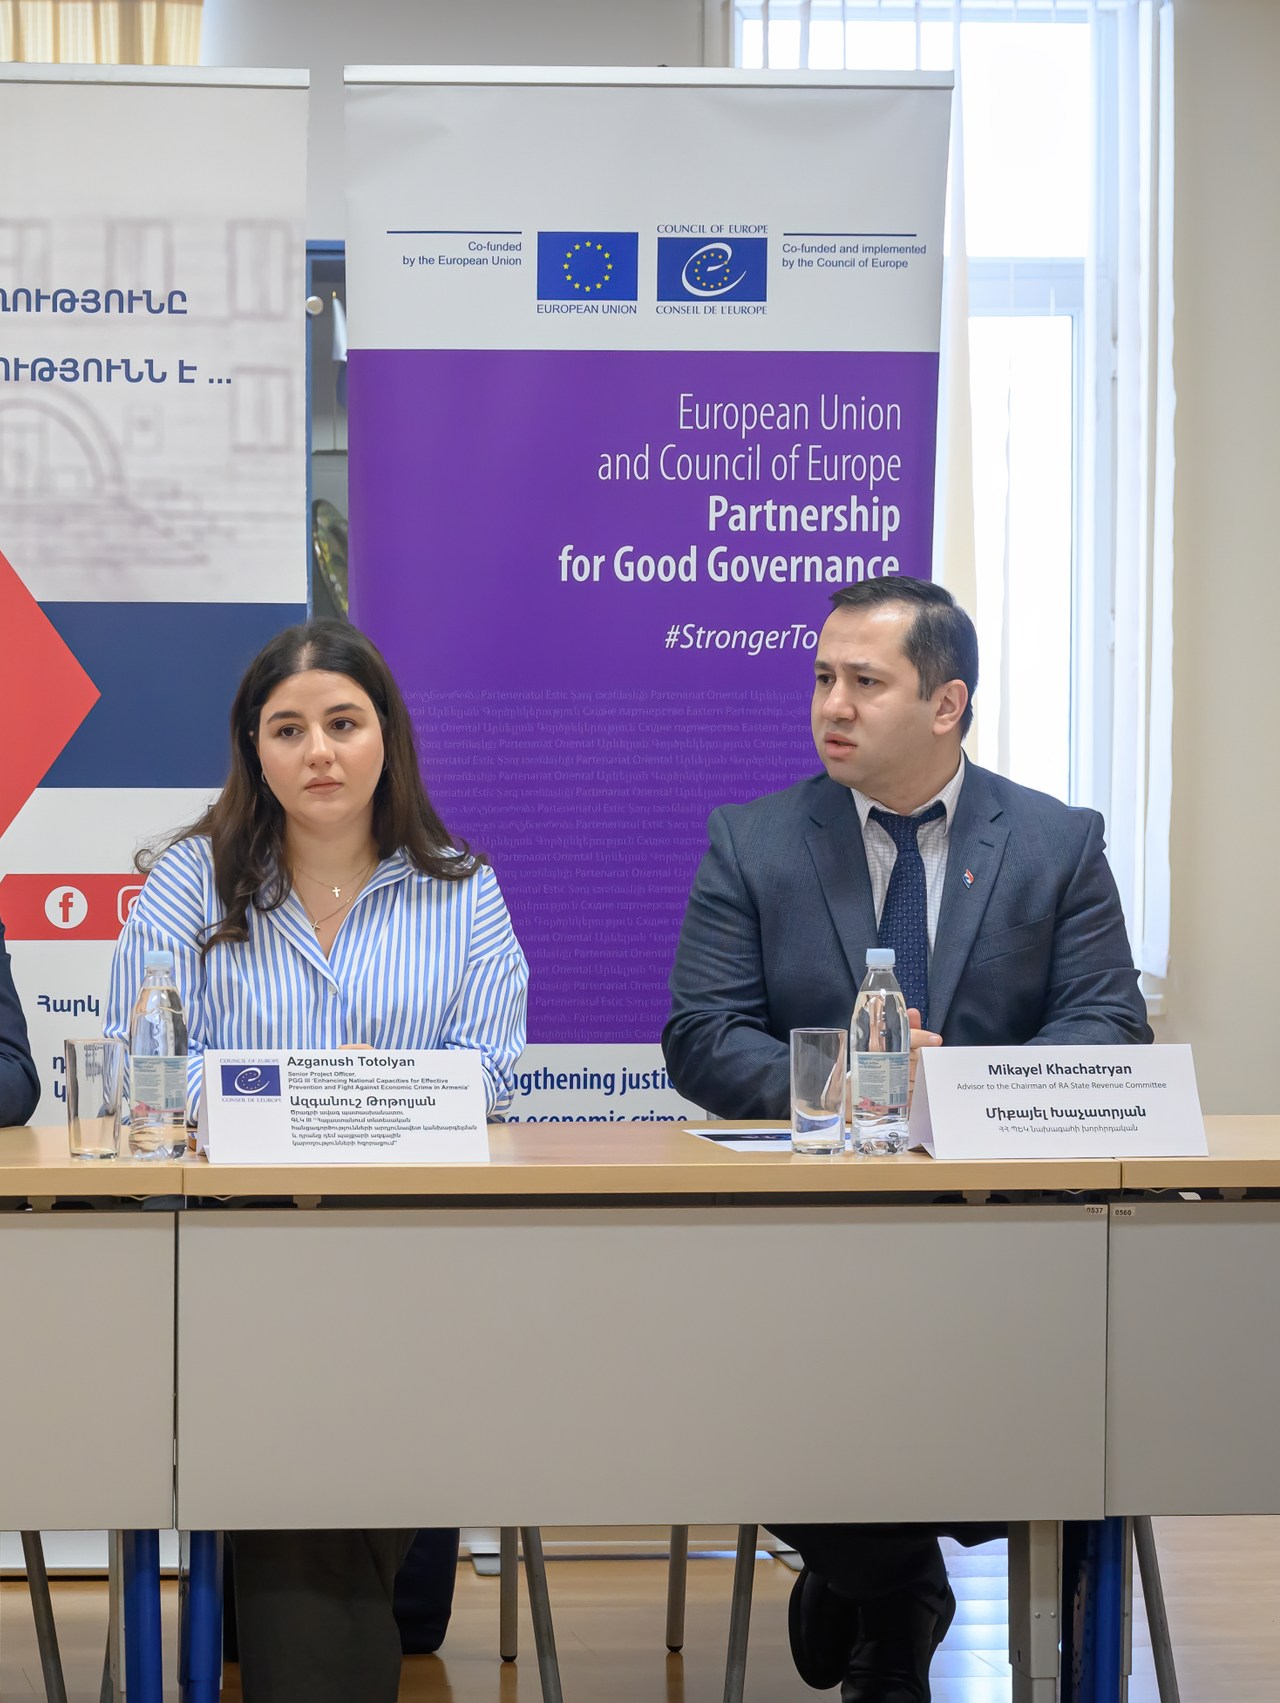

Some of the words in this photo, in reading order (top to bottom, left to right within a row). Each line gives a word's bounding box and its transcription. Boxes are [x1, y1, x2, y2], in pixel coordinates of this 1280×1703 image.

[657, 225, 706, 233] COUNCIL
[711, 225, 724, 233] OF
[729, 225, 767, 233] EUROPE
[468, 241, 521, 251] Co-funded
[783, 244, 836, 253] Co-funded
[840, 244, 858, 253] and
[862, 244, 926, 255] implemented
[403, 256, 415, 267] by
[419, 256, 435, 264] the
[439, 255, 488, 267] European
[492, 256, 521, 265] Union
[782, 258, 794, 269] by
[798, 258, 813, 267] the
[817, 258, 855, 267] Council
[859, 258, 868, 267] of
[872, 258, 908, 269] Europe
[537, 304, 598, 313] EUROPEAN
[602, 305, 636, 314] UNION
[656, 306, 700, 314] CONSEIL
[704, 306, 716, 314] DE
[721, 306, 766, 314] L'EUROPE
[179, 360, 197, 383] Է
[680, 394, 808, 439] European
[821, 394, 900, 430] Union
[598, 444, 648, 480] and
[660, 444, 760, 480] Council
[772, 444, 801, 480] of
[809, 445, 901, 490] Europe
[709, 495, 900, 541] Partnership
[559, 545, 605, 581] for
[614, 545, 696, 582] Good
[708, 546, 899, 582] Governance
[665, 624, 818, 655] #StrongerTo
[37, 995, 99, 1016] Հարկ
[287, 1057, 353, 1068] Azganush
[358, 1057, 414, 1069] Totolyan
[988, 1064, 1042, 1077] Mikayel
[1046, 1063, 1132, 1076] Khachatryan
[513, 1067, 615, 1095] gthening
[291, 1096, 362, 1108] Ազգանուշ
[986, 1107, 1048, 1121] Միքայել
[1051, 1106, 1146, 1120] Խաչատրյան
